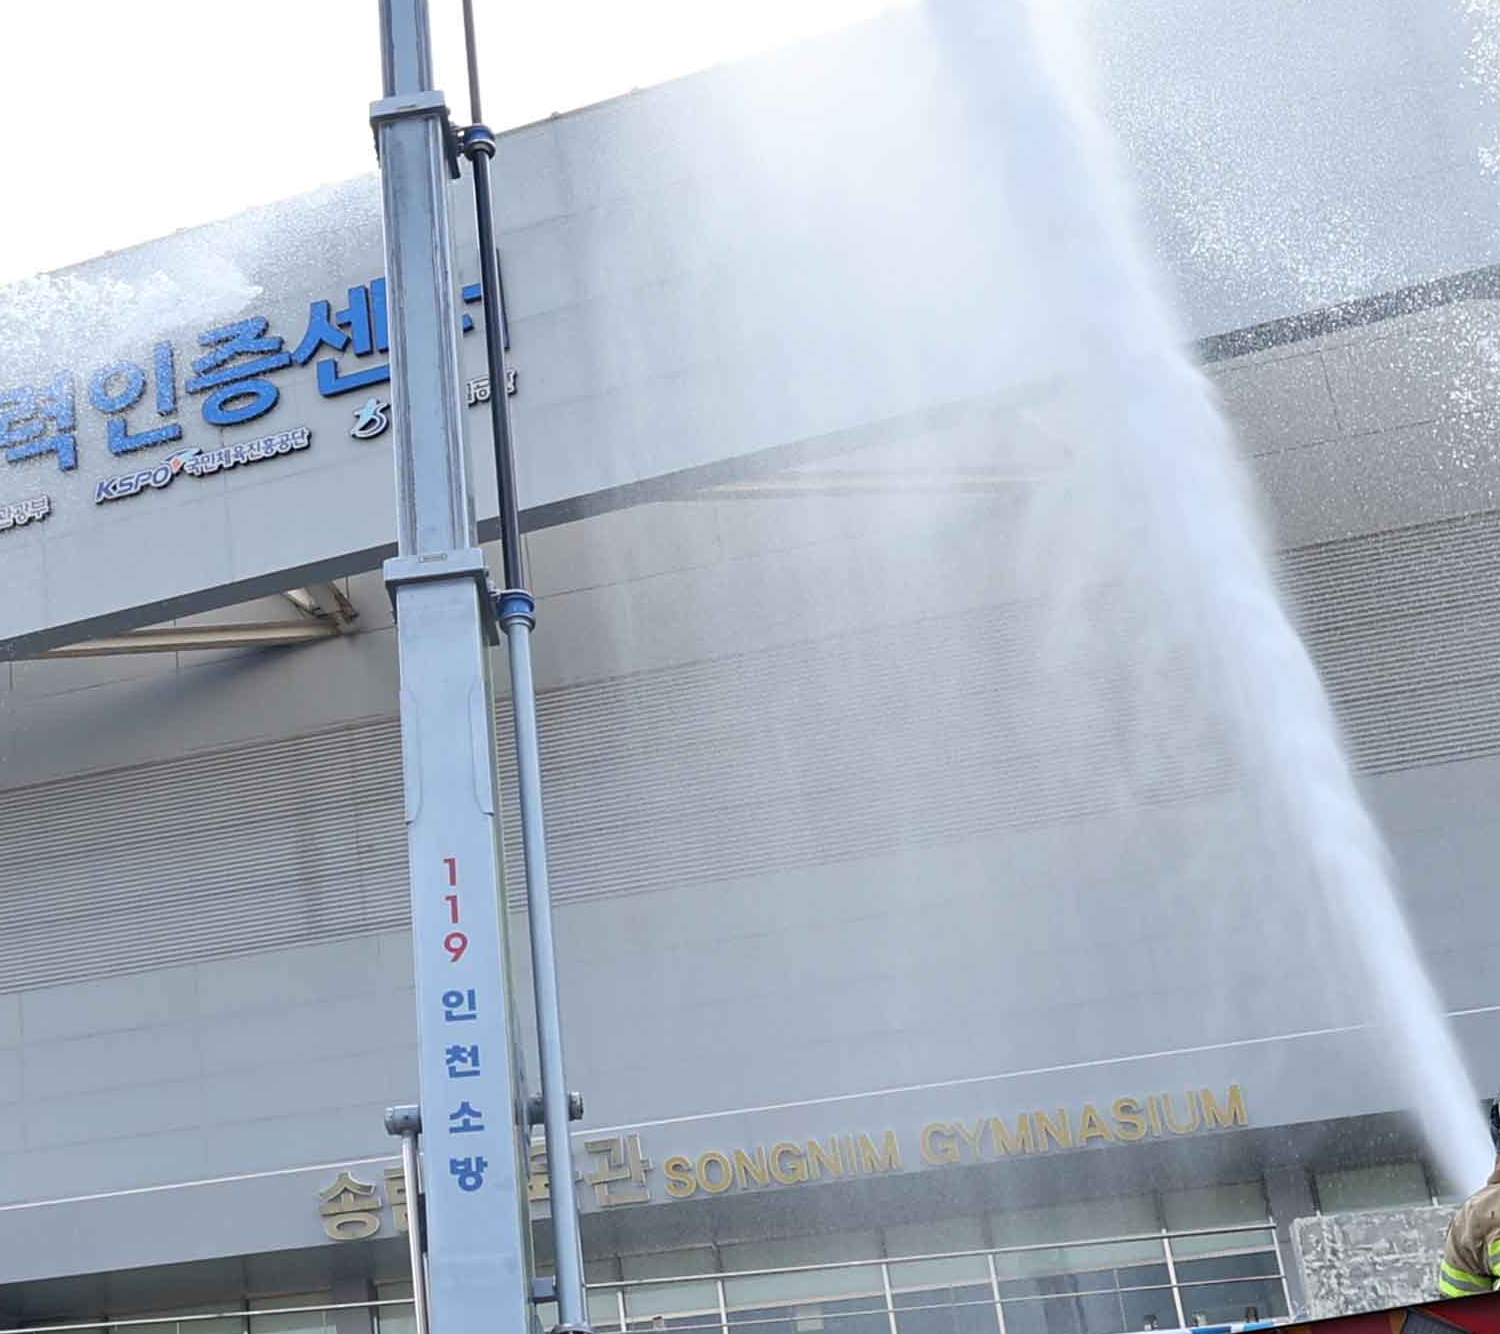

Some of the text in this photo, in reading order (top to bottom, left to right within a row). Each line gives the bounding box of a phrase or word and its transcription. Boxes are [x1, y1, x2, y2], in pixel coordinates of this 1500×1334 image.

[95, 426, 312, 504] KSPO 국민체육진흥공단
[442, 858, 488, 1193] 119 인천소방
[664, 1129, 901, 1198] SONGNIM
[920, 1083, 1249, 1166] GYMNASIUM
